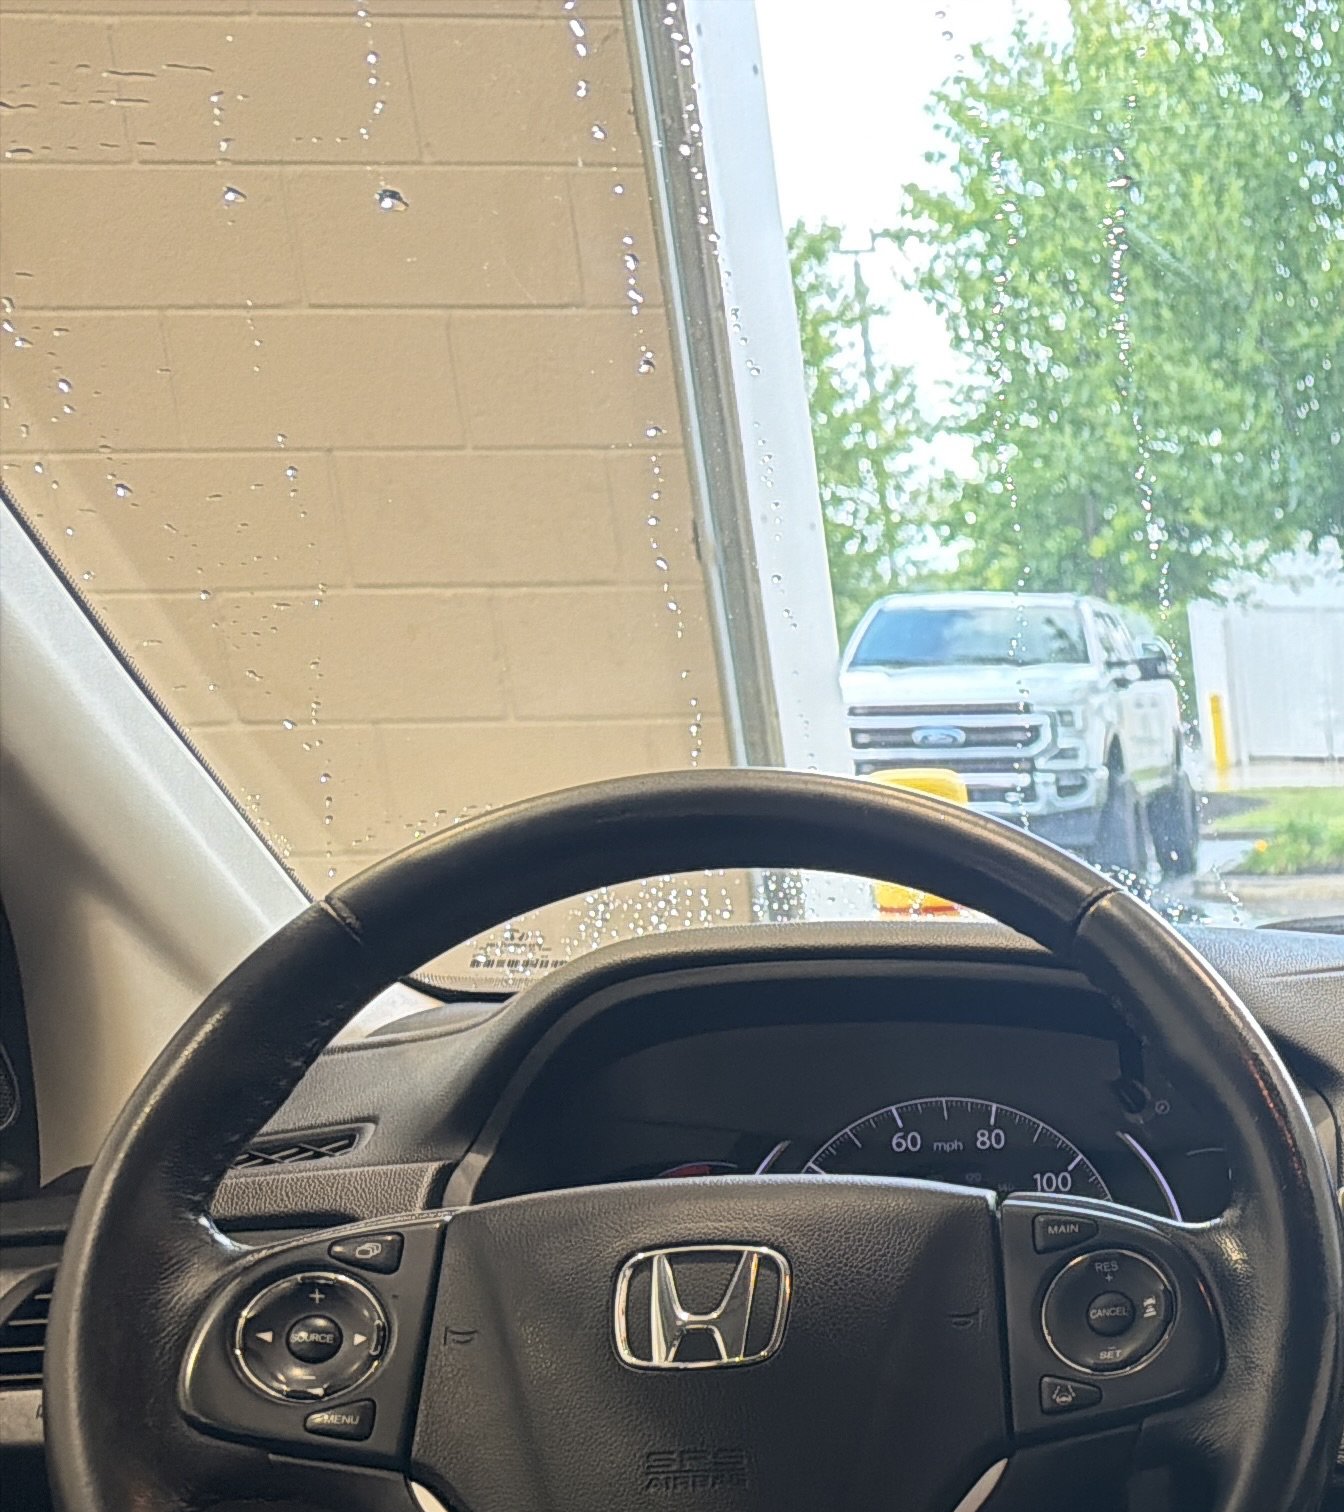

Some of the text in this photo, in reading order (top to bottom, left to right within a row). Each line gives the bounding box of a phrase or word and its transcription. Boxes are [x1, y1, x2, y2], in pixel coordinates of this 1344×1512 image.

[891, 1129, 1005, 1154] 60 mph 80
[1033, 1172, 1072, 1193] 100
[1048, 1224, 1079, 1234] MAIN
[1095, 1261, 1119, 1272] RES
[1090, 1308, 1128, 1320] CANCEL
[290, 1333, 334, 1344] SOURCE
[1100, 1350, 1122, 1359] SET
[324, 1414, 360, 1426] MENU
